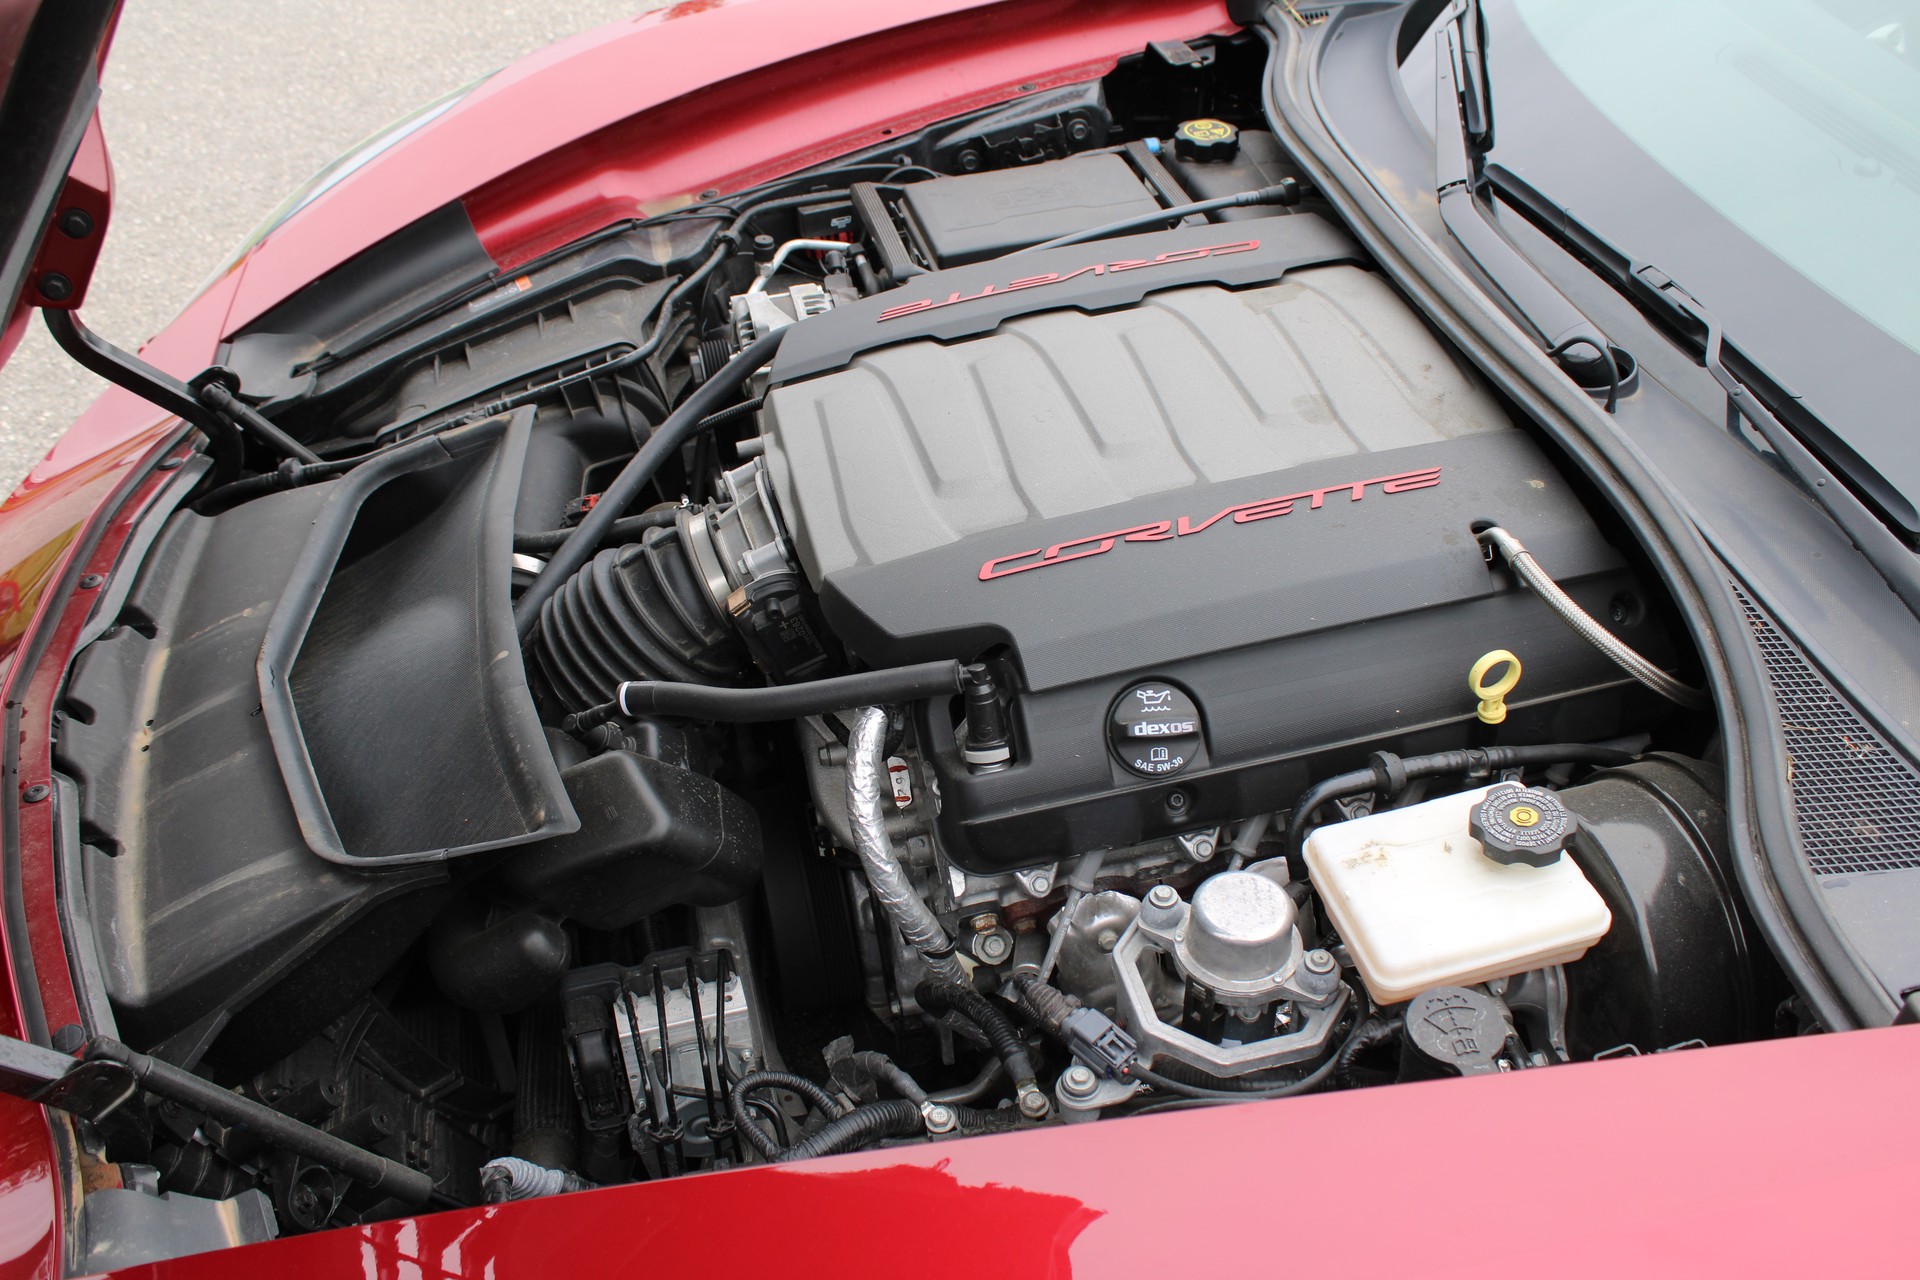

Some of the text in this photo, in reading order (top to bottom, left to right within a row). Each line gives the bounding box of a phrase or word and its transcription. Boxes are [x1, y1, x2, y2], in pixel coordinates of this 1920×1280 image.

[878, 240, 1260, 322] CORVETTE
[978, 466, 1442, 581] CORVETTE
[1134, 721, 1195, 736] dexos
[1134, 756, 1184, 772] SAE 5W-30
